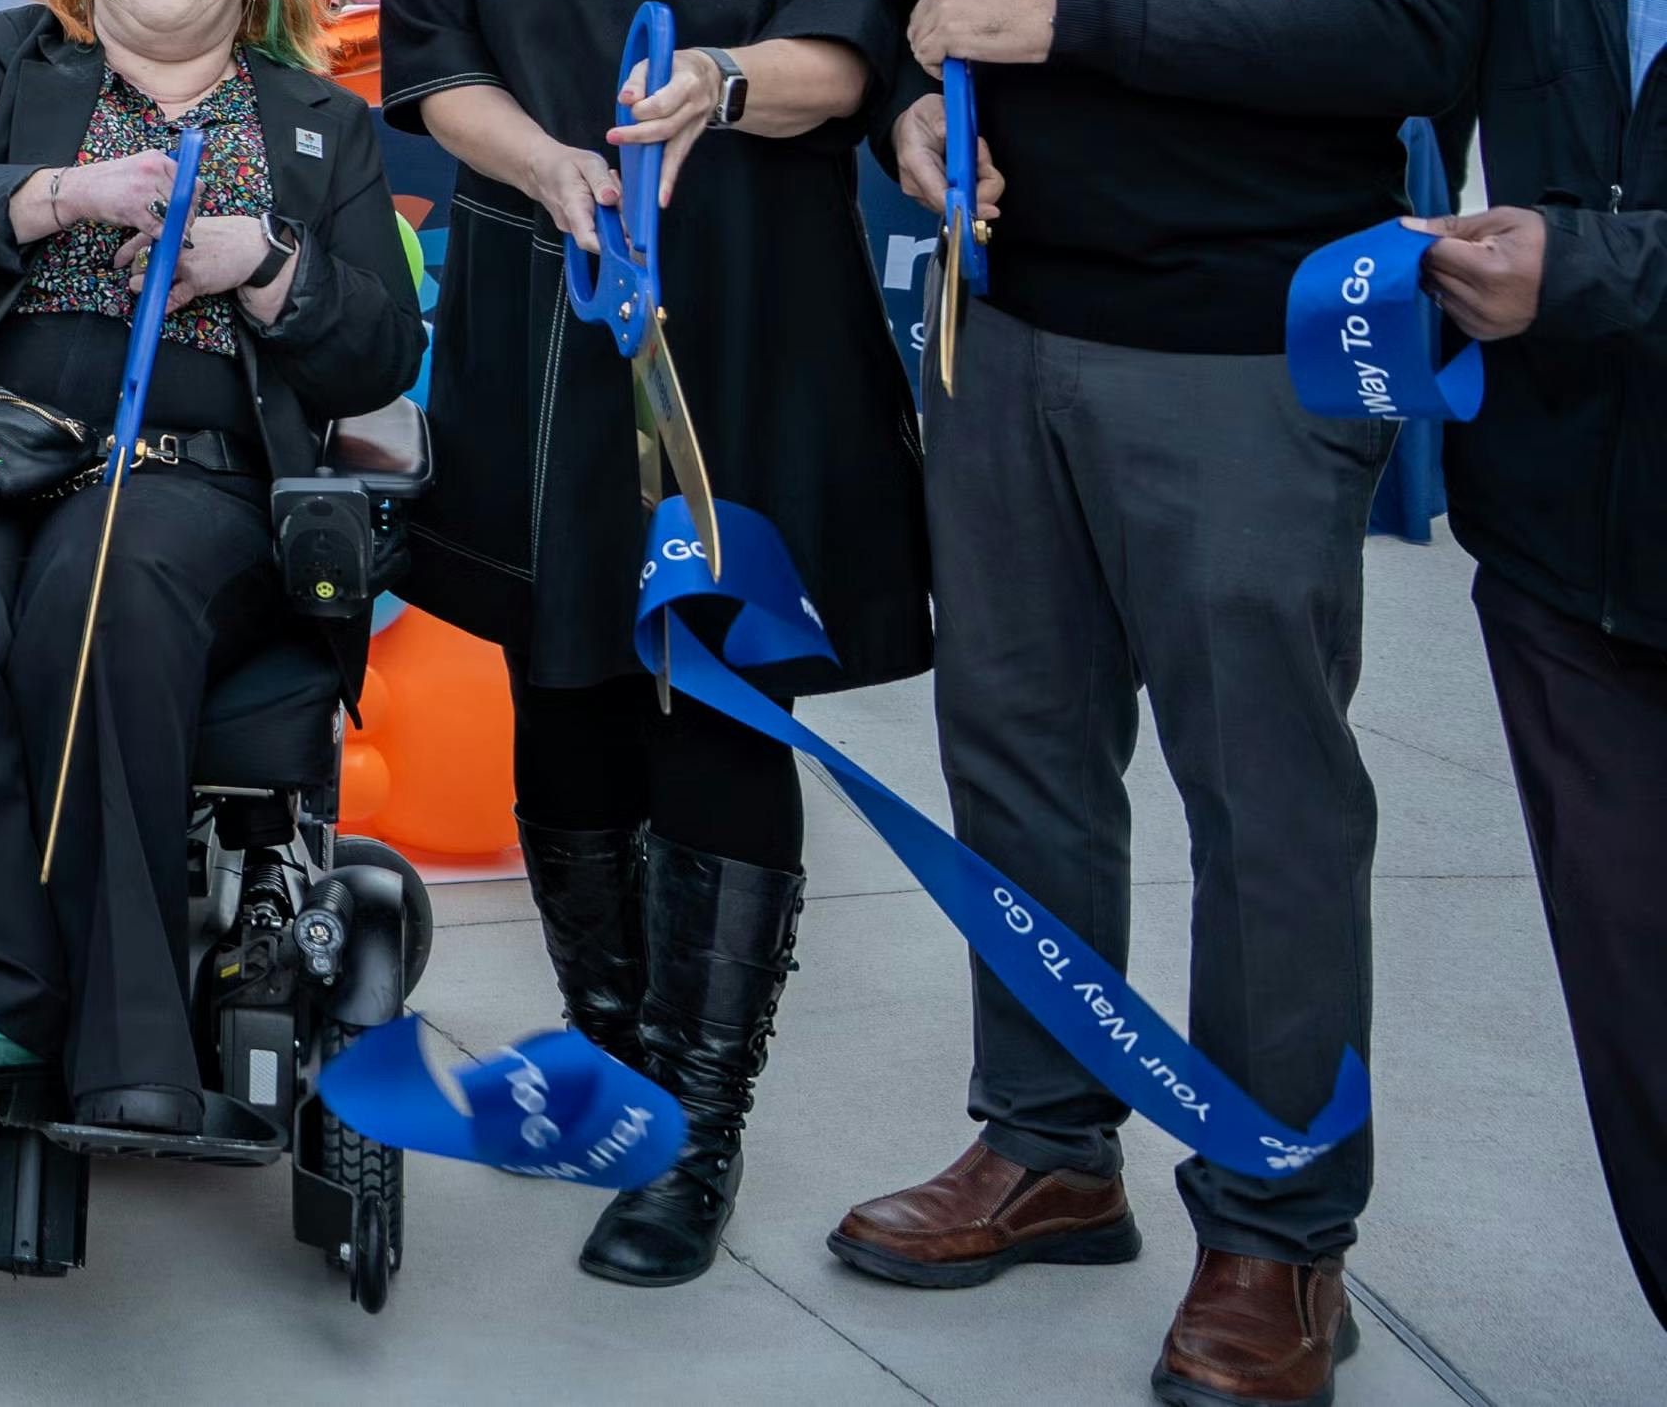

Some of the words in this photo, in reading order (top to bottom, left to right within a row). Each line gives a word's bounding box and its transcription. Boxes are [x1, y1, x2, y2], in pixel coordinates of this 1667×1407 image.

[1342, 257, 1375, 305] Go
[1340, 315, 1372, 353] To
[1354, 360, 1397, 414] Way
[993, 887, 1033, 934] Go
[1037, 938, 1070, 981] To
[1073, 982, 1138, 1054] Way
[1140, 1056, 1212, 1123] Your
